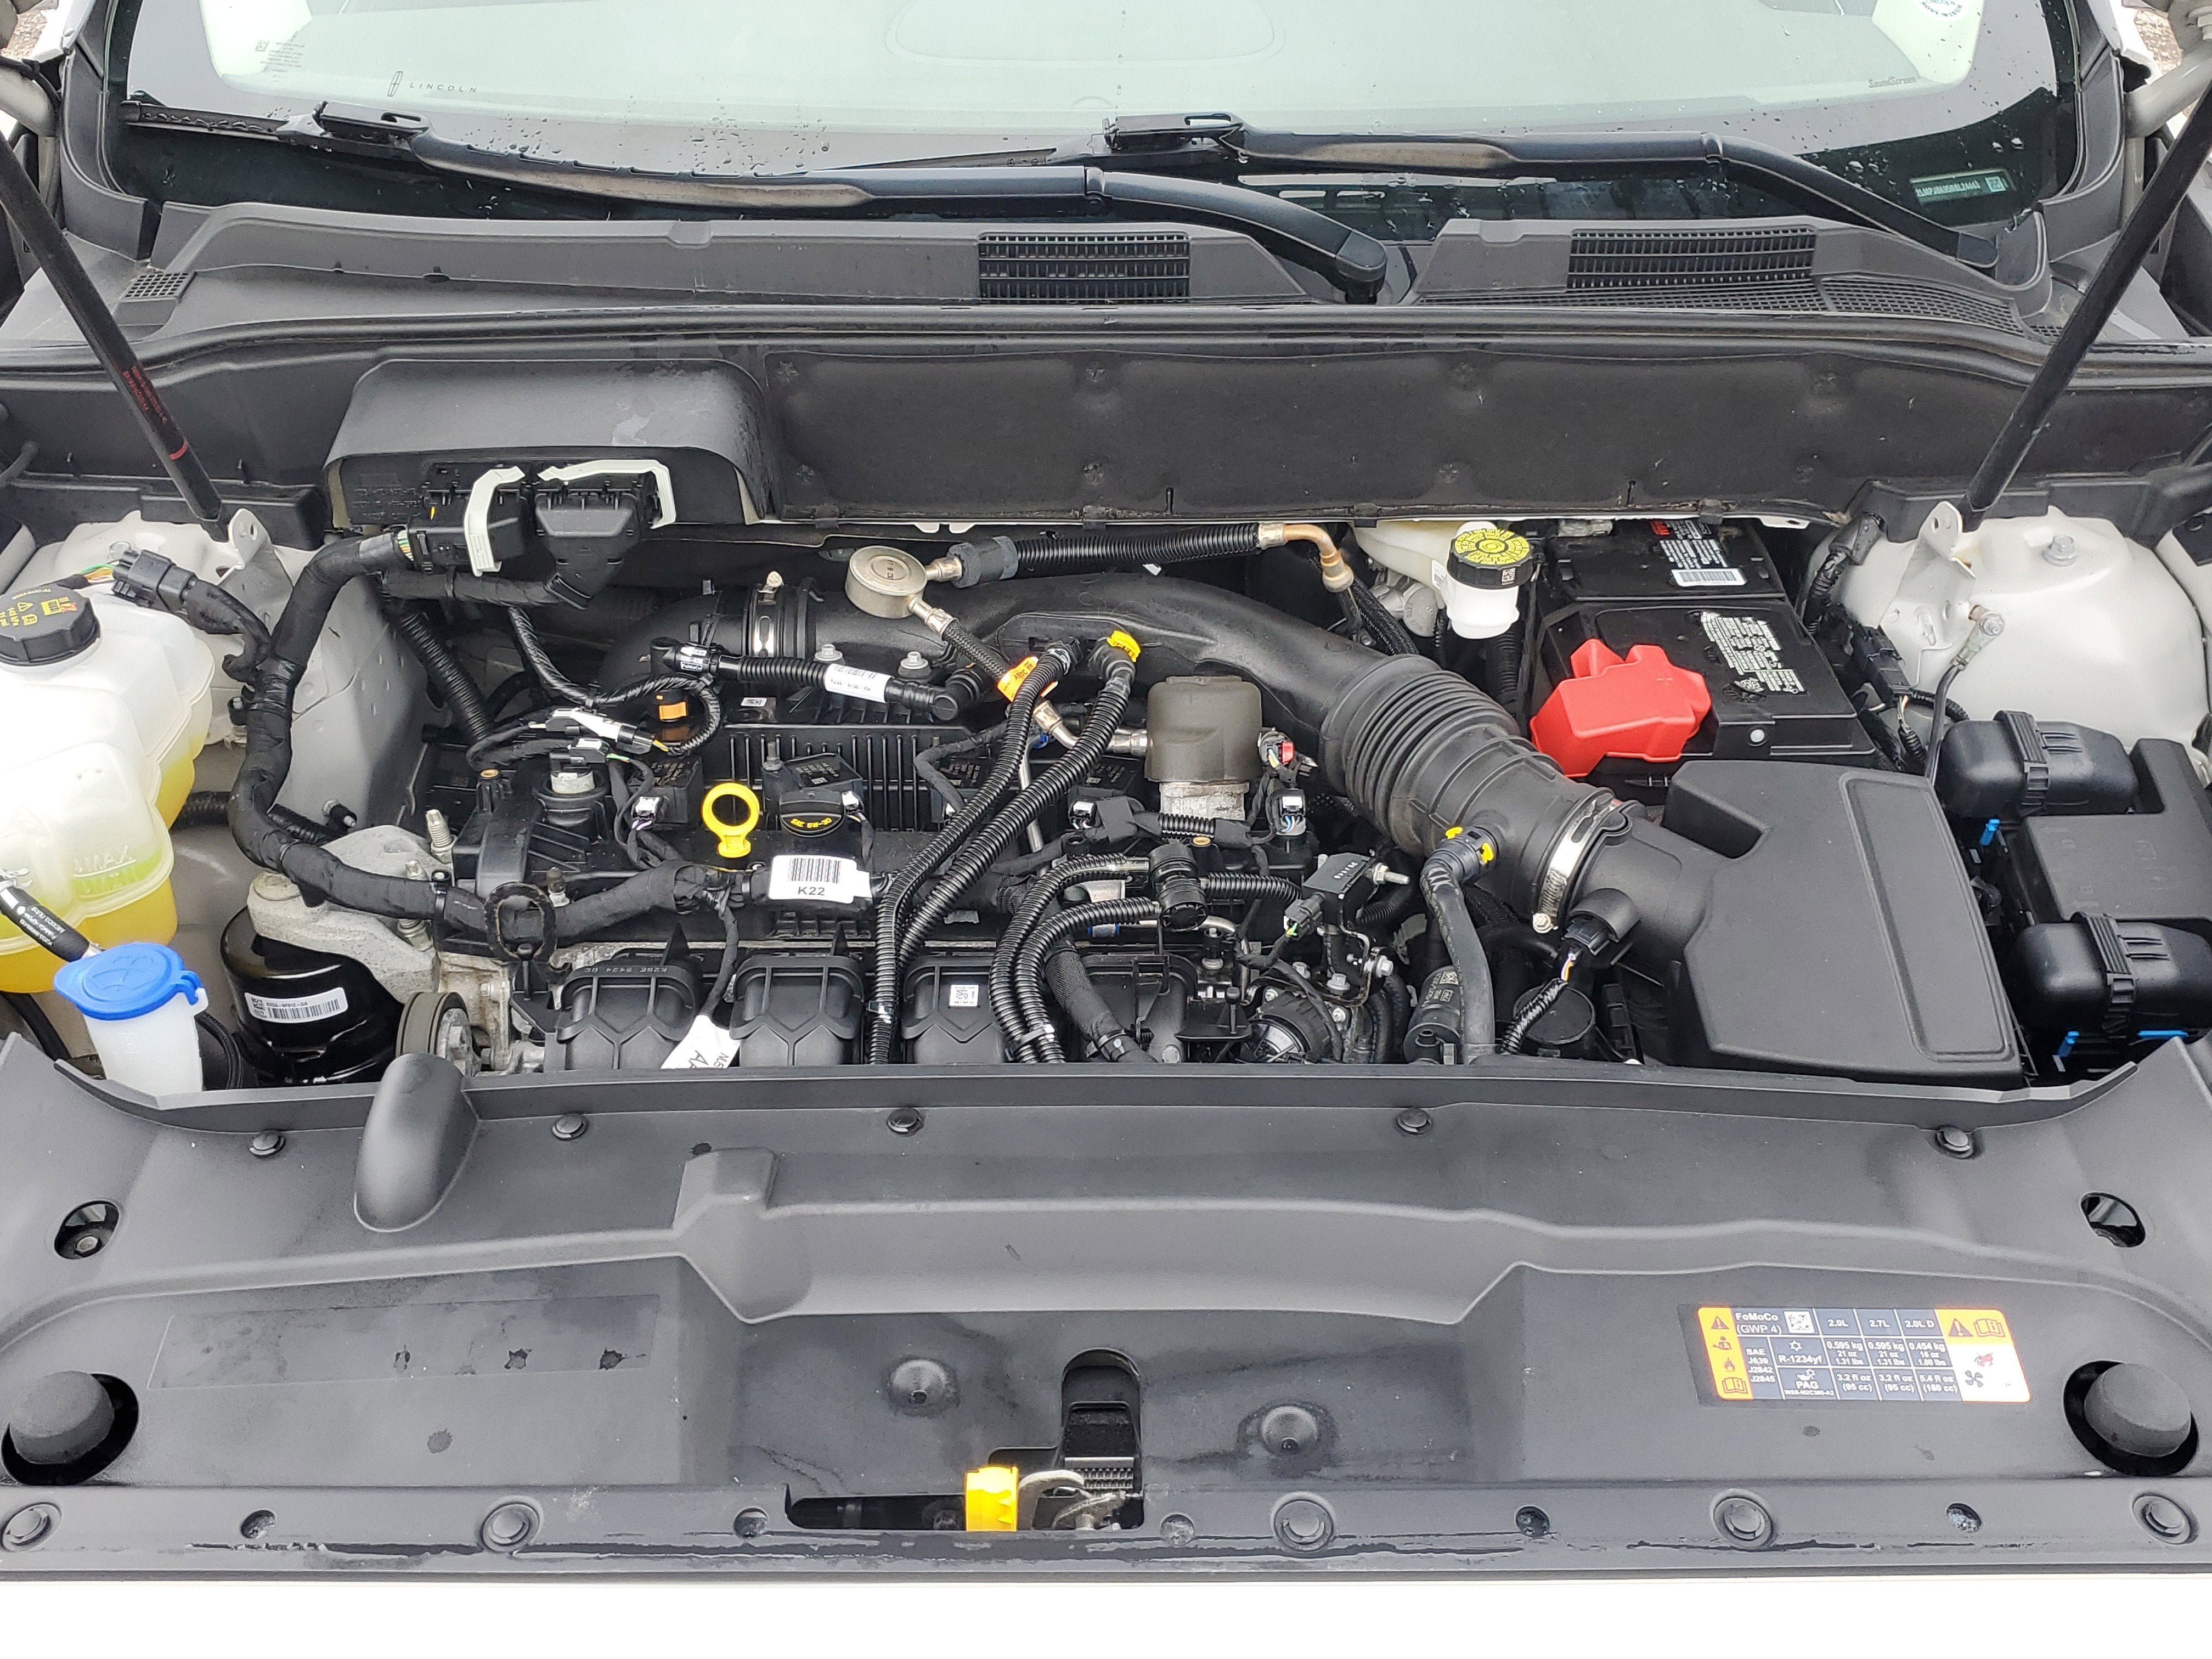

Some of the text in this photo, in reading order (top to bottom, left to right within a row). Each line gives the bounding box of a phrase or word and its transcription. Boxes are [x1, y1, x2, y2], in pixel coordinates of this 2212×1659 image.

[410, 82, 477, 93] LINCOLN
[798, 887, 825, 896] K22
[1735, 1312, 1779, 1322] FoMoCo
[1827, 1319, 1849, 1328] 2.0L
[1868, 1319, 1891, 1328] 2.7L
[1904, 1320, 1935, 1328] 2.0L D
[1736, 1324, 1782, 1335] (GWP 4)
[1826, 1341, 1864, 1352] 0.595 kg
[1867, 1341, 1905, 1352] 0.595 kg
[1934, 1342, 1946, 1353] kg
[1778, 1355, 1822, 1365] R-1234yf
[1934, 1358, 1947, 1367] lbs
[1878, 1374, 1893, 1382] 3.2
[1795, 1380, 1820, 1390] PAG
[1858, 1383, 1873, 1392] cc)
[1900, 1383, 1915, 1393] cc)
[1943, 1384, 1958, 1394] cc)
